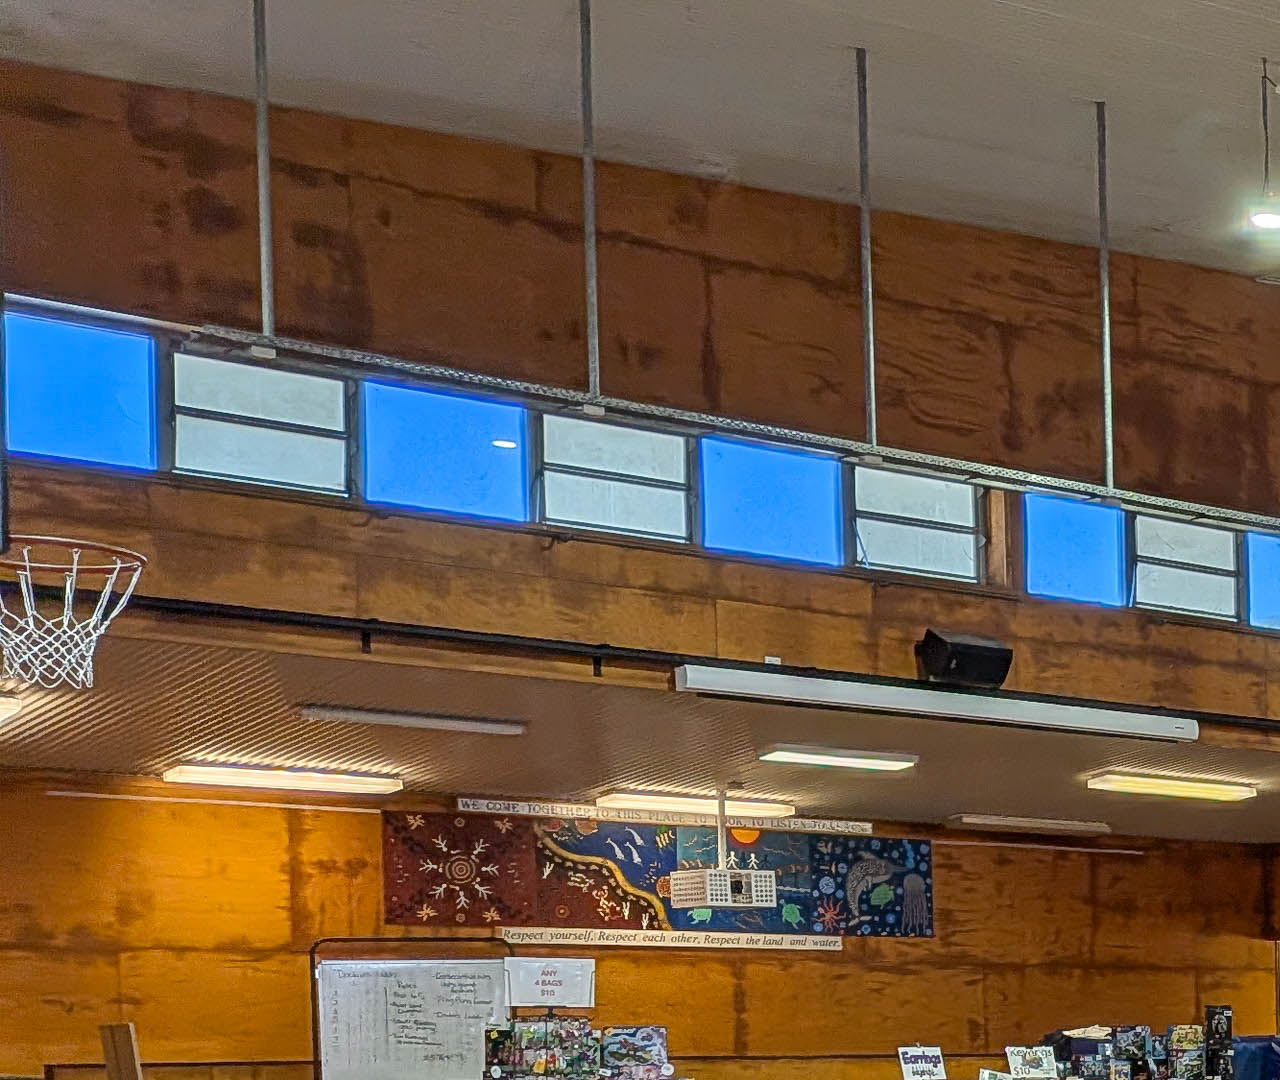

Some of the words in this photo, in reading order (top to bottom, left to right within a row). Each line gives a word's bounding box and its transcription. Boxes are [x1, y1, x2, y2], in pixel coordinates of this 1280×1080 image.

[460, 799, 480, 810] WE
[486, 801, 520, 813] COME
[527, 803, 591, 817] TOGETHER
[594, 807, 609, 818] TO
[617, 809, 642, 820] THIS
[751, 816, 764, 827] TO
[504, 930, 544, 941] Respect
[598, 931, 638, 943] Respect
[643, 932, 666, 943] each
[704, 934, 740, 946] Respect
[746, 935, 760, 946] the
[763, 935, 783, 946] land
[790, 936, 807, 947] and
[540, 969, 558, 977] ANY
[541, 979, 562, 987] BAGS
[1013, 1066, 1031, 1076] $10
